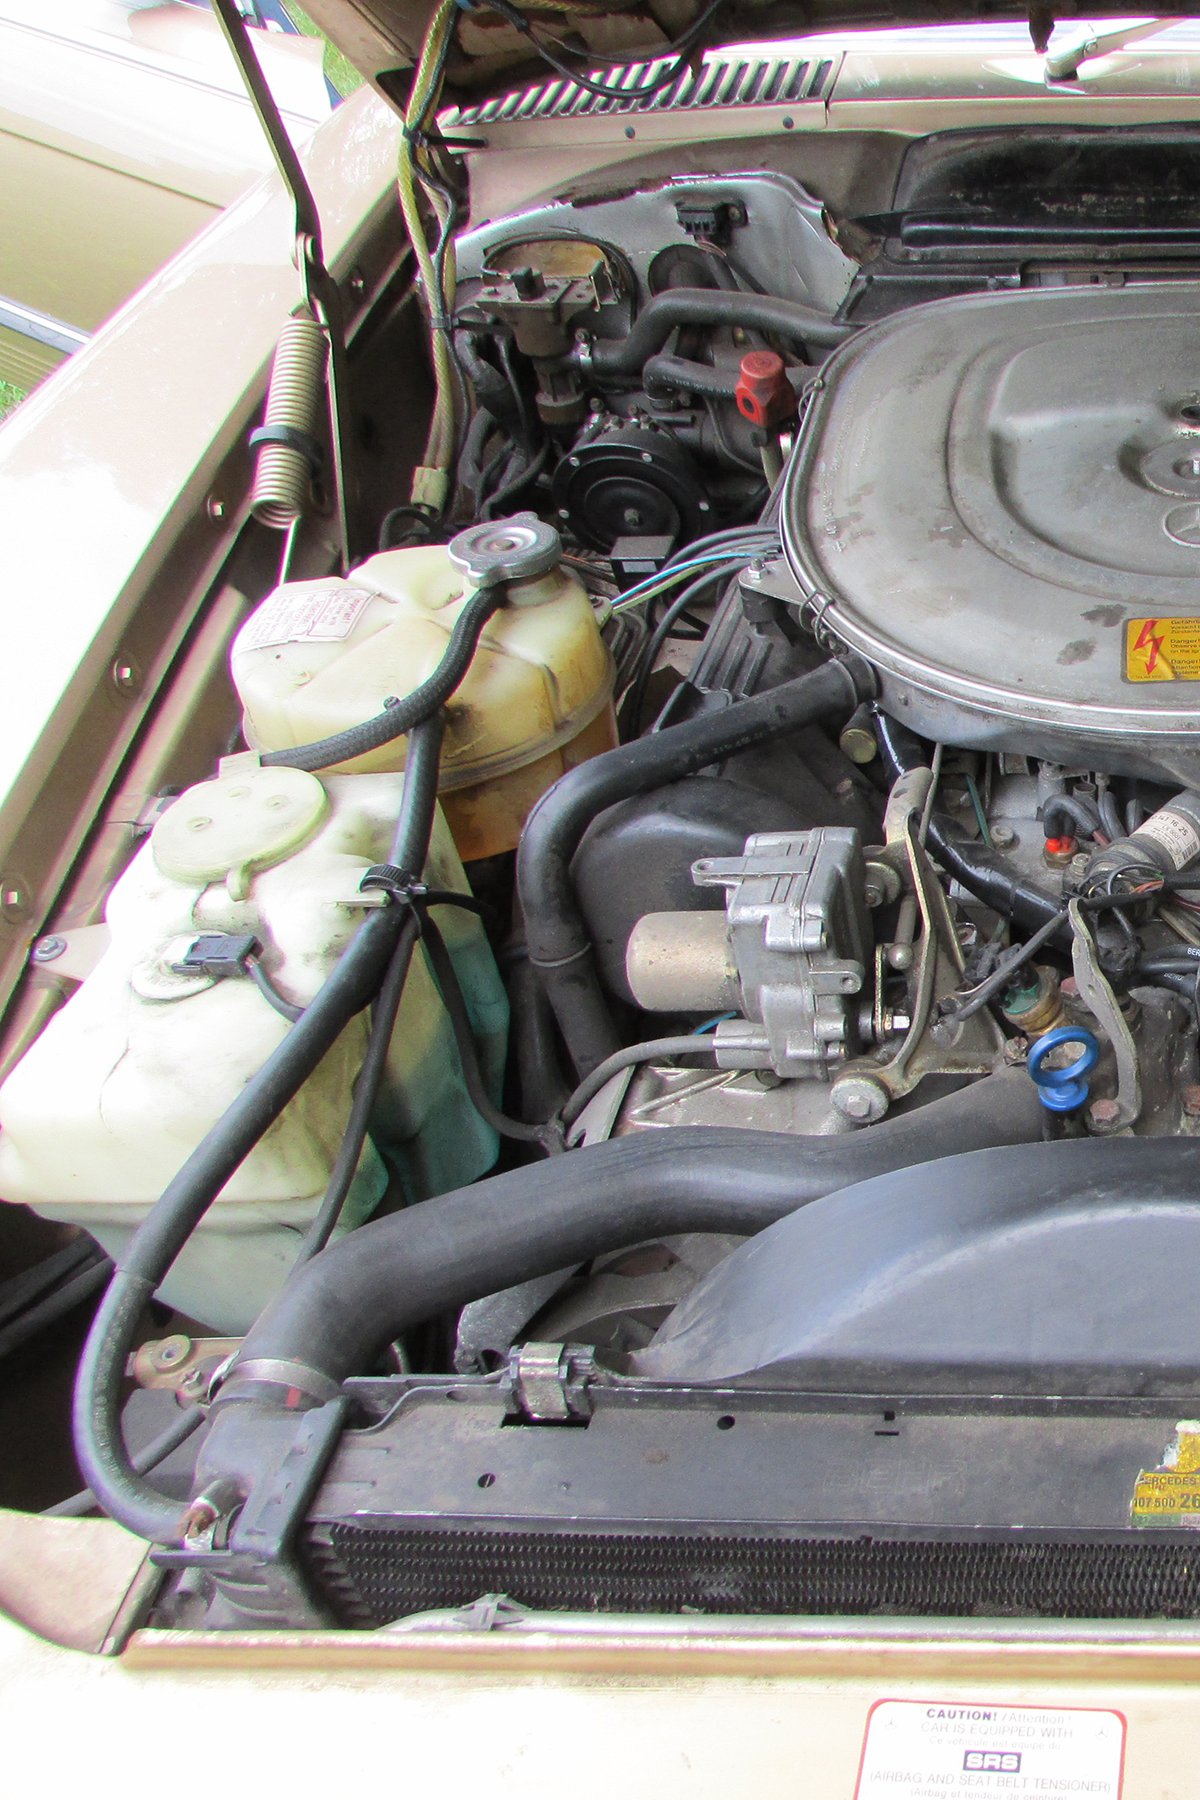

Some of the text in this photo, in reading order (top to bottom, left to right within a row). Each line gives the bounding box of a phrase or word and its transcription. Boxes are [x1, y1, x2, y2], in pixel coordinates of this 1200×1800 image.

[926, 1708, 997, 1721] CAUTION!
[921, 1721, 1073, 1739] CAR IS EQUIPPED WITH
[965, 1752, 1019, 1771] SRS
[870, 1770, 1111, 1793] (AIRBAG AND SEAT BELT TENSIONER)
